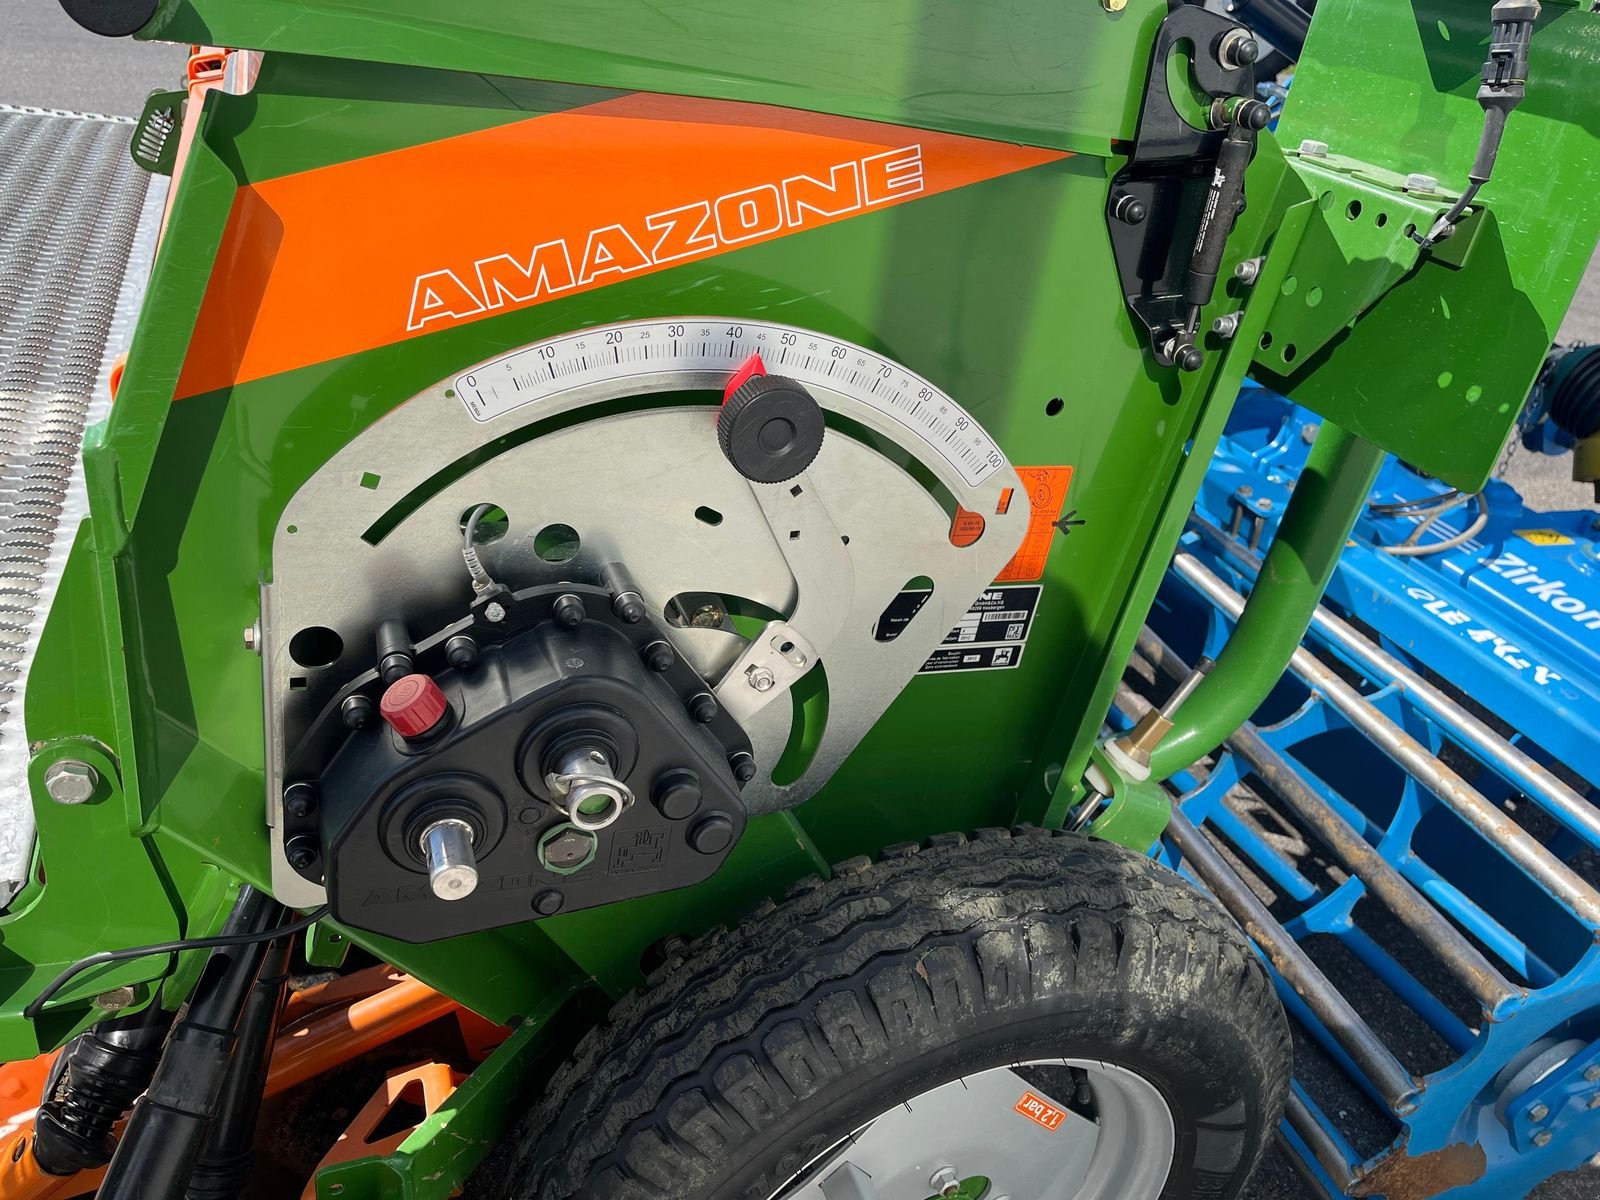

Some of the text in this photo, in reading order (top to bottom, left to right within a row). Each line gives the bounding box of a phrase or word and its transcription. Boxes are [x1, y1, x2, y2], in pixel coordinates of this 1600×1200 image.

[405, 143, 925, 332] AMAZONE
[466, 375, 477, 388] 0
[537, 345, 556, 360] 10
[574, 341, 586, 350] 15
[605, 330, 623, 345] 20
[640, 331, 651, 339] 25
[667, 324, 686, 338] 30
[700, 328, 711, 337] 35
[726, 326, 743, 339] 40
[757, 332, 767, 341] 45
[780, 333, 797, 347] 50
[808, 342, 818, 351] 55
[831, 346, 848, 360] 60
[856, 358, 867, 367] 65
[877, 364, 893, 379] 70
[900, 378, 910, 388] 75
[918, 387, 934, 403] 80
[939, 405, 949, 415] 85
[954, 417, 970, 431] 90
[973, 436, 982, 447] 95
[985, 449, 1003, 469] 100
[1478, 552, 1600, 630] Zirkon
[1023, 1099, 1060, 1126] 1,2 bar
